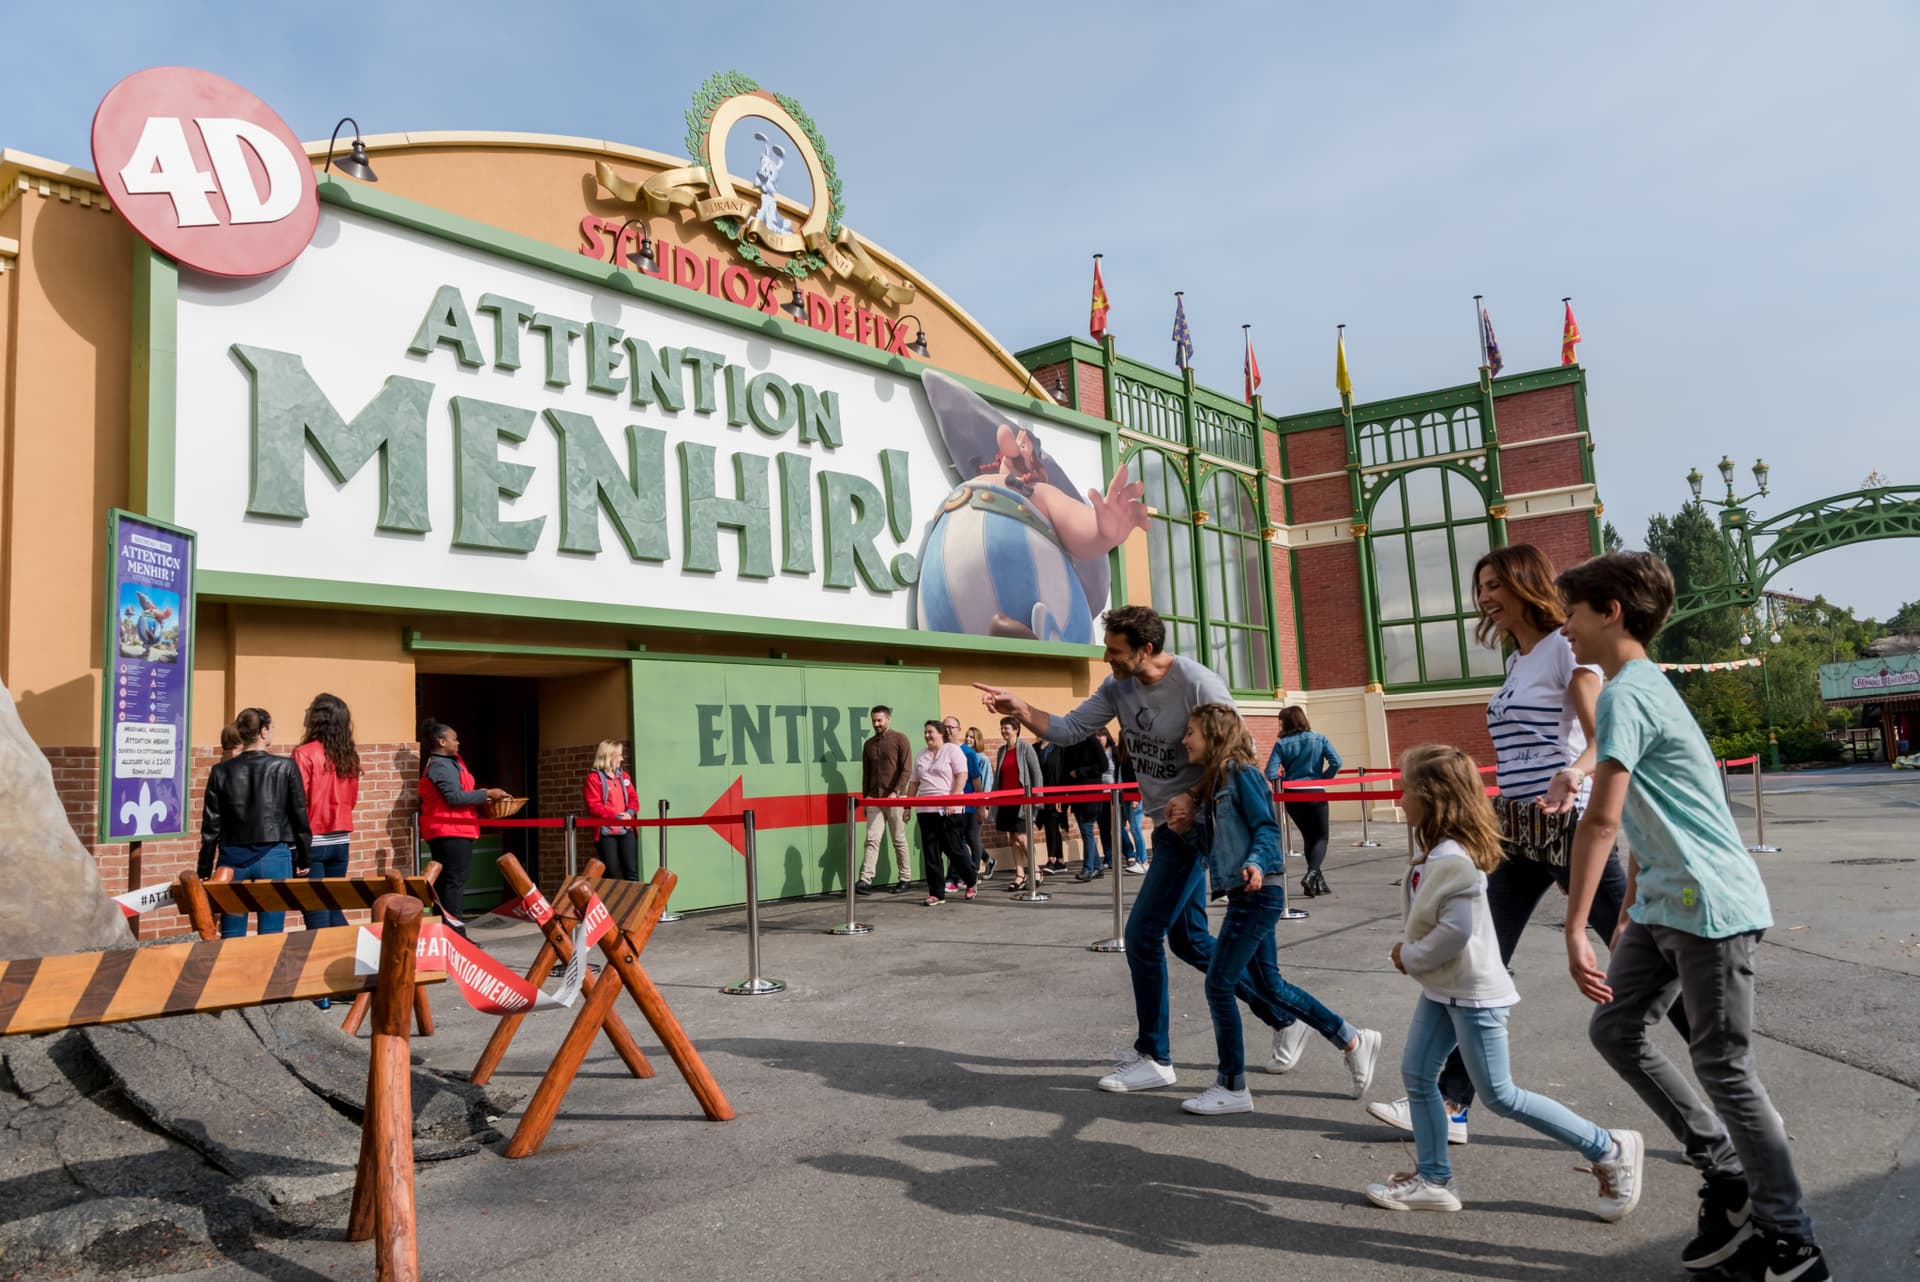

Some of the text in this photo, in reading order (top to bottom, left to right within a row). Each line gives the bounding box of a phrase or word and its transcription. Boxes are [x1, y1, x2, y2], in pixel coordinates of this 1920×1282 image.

[119, 116, 303, 229] 4D
[580, 215, 911, 359] STUDIOS DÉFIX
[410, 284, 844, 450] ATTENTION
[229, 342, 921, 594] MENHIR!
[121, 545, 181, 570] ATTENTION
[127, 559, 169, 581] MENHIR
[695, 704, 893, 766] ENTRE
[1160, 748, 1176, 762] DE
[416, 936, 529, 1010] #ATTENTIONMENHIR
